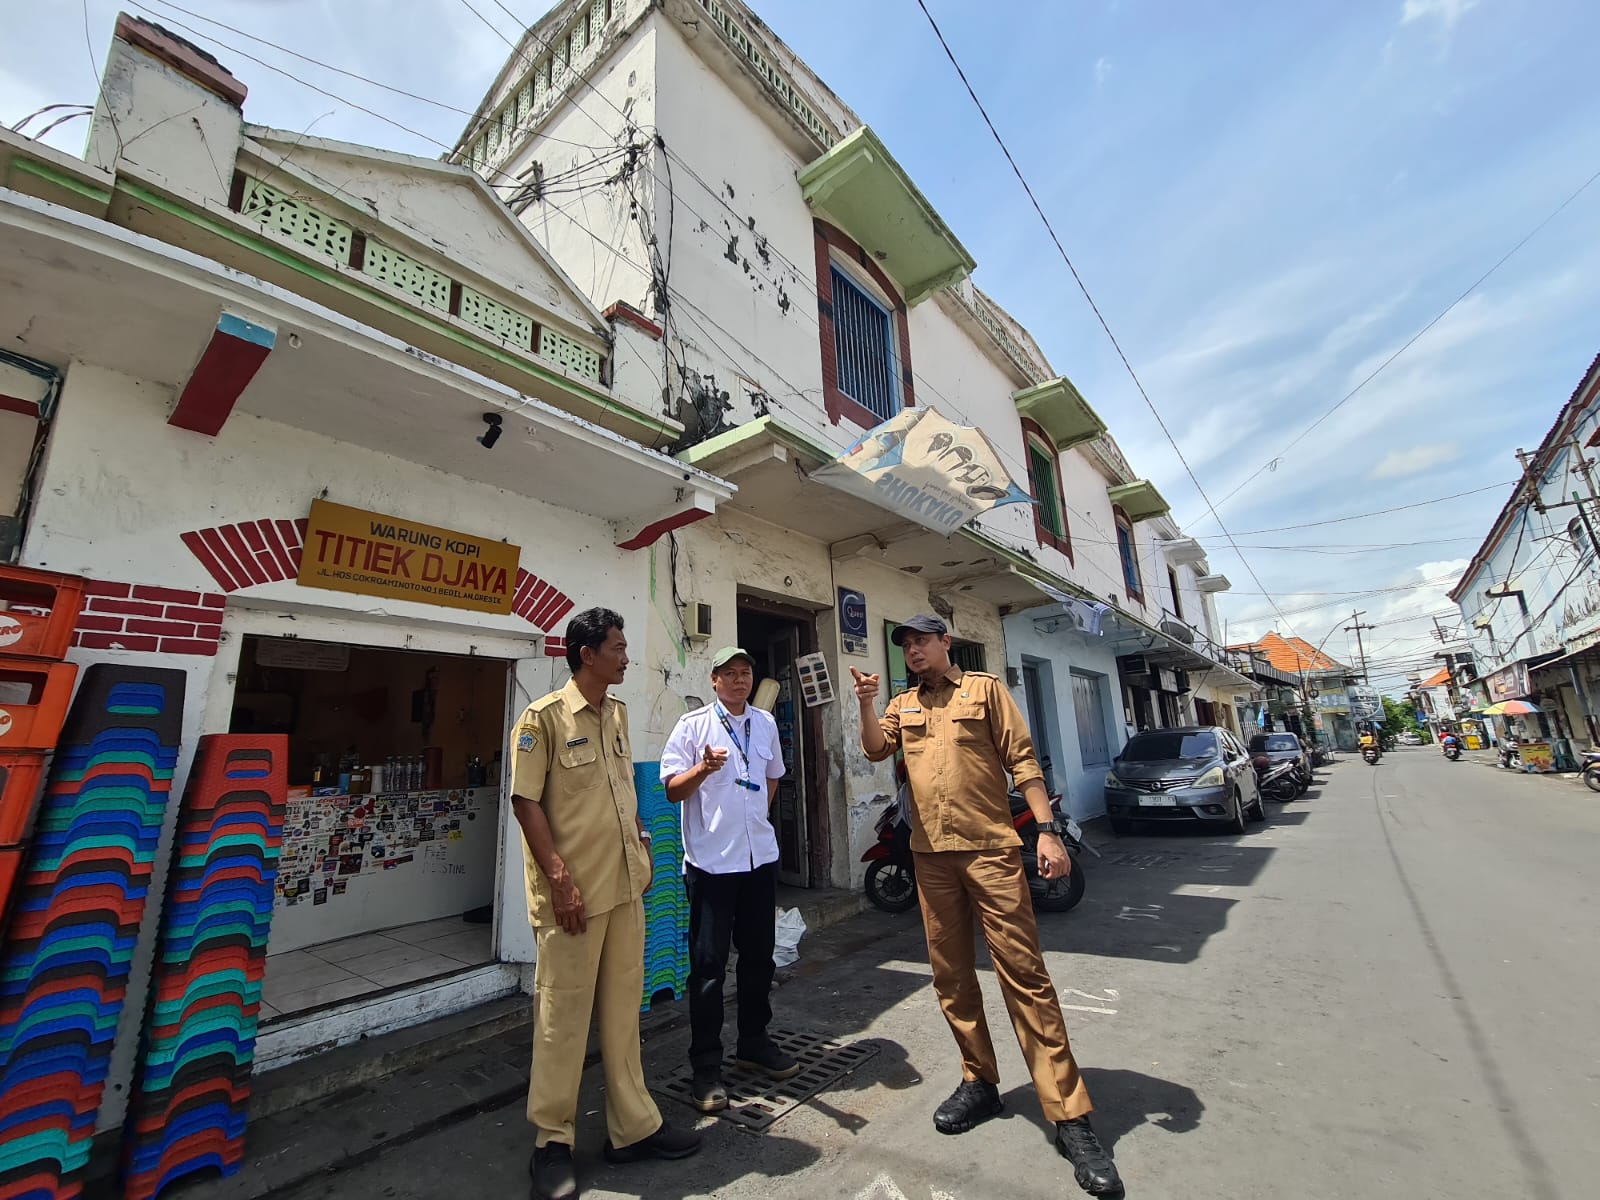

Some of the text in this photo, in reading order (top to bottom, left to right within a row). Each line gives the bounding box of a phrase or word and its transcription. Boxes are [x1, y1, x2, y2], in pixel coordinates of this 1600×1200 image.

[315, 529, 507, 595] TITIEK DJAYA
[370, 521, 480, 558] WARUNG KOPI
